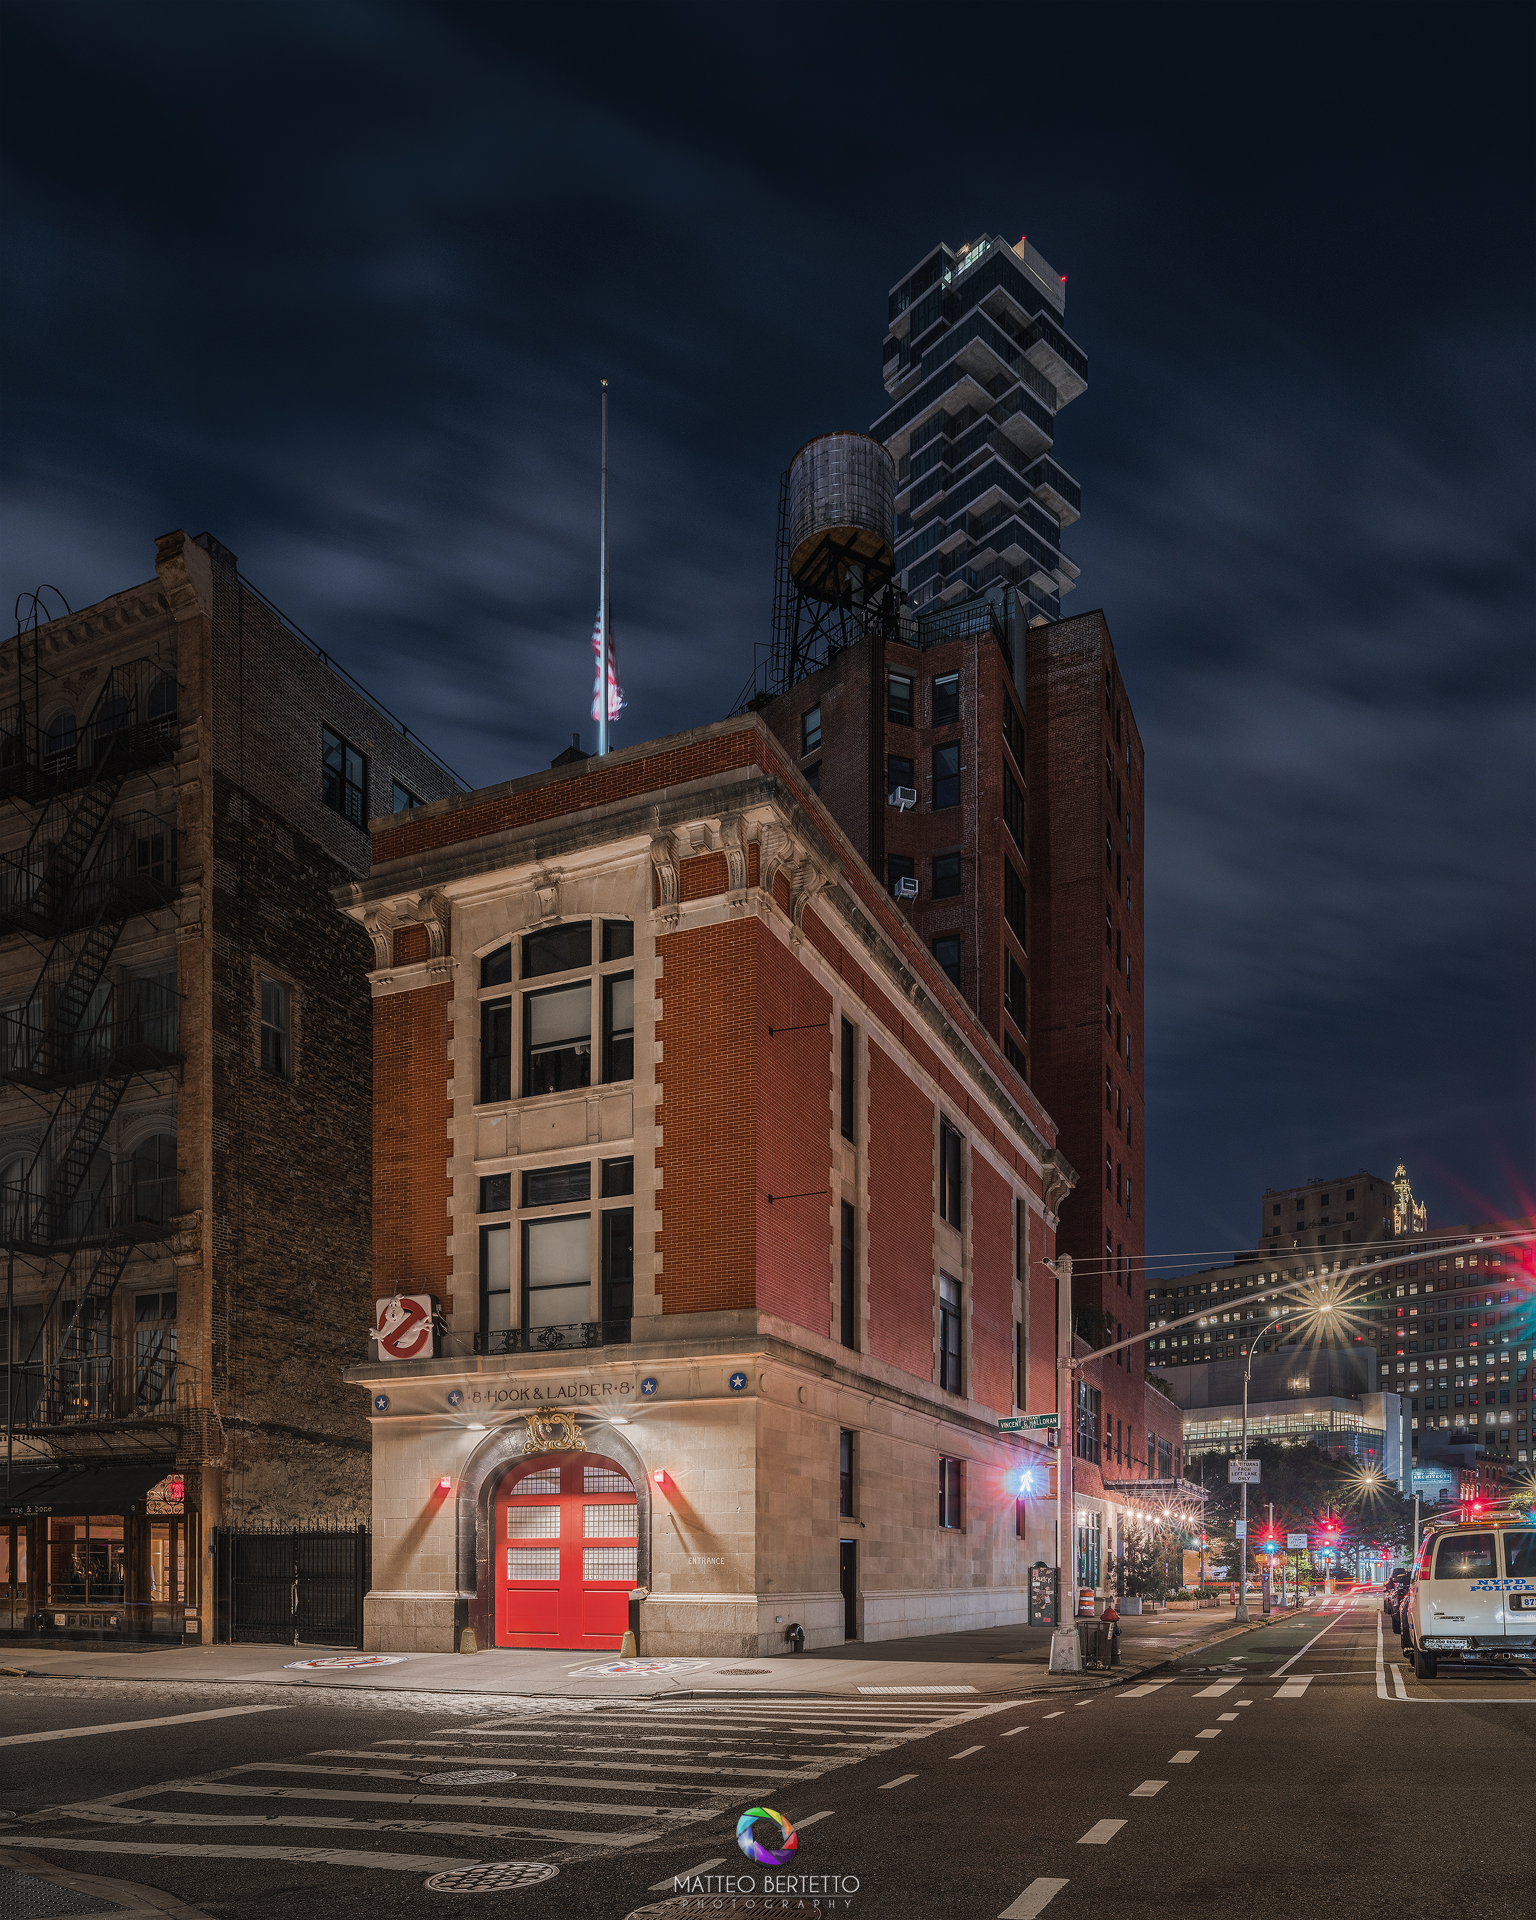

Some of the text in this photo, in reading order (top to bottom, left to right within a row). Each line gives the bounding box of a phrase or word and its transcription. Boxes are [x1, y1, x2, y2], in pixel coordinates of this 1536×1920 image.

[487, 1388, 530, 1403] HOOK
[533, 1387, 544, 1400] &
[547, 1382, 613, 1399] LADDER
[1029, 1417, 1056, 1426] HALLORAN
[26, 1505, 32, 1513] &
[34, 1505, 53, 1513] bone
